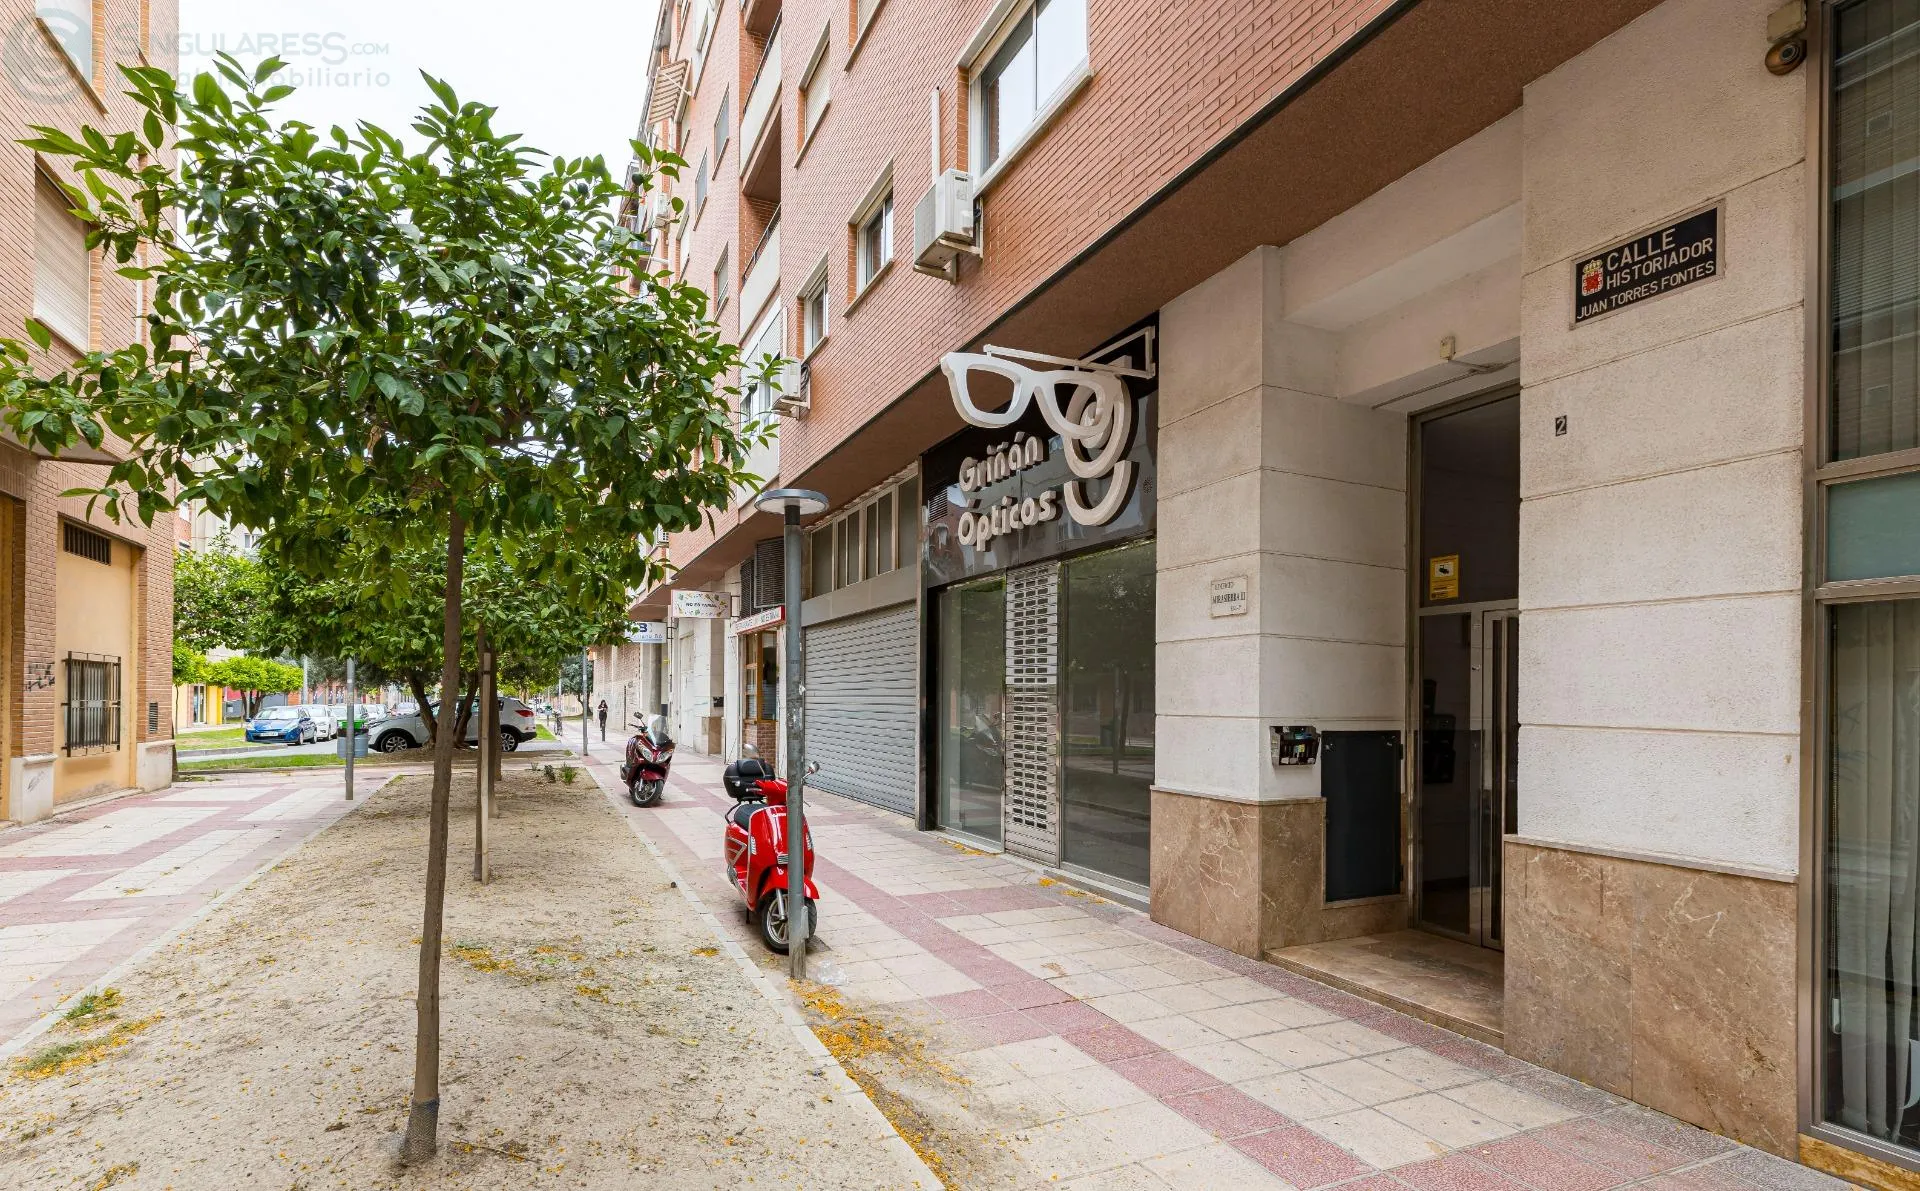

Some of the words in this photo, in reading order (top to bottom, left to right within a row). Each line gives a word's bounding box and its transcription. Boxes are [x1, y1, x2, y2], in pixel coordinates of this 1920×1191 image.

[1607, 228, 1676, 271] CALLE
[1607, 237, 1713, 290] HISTORIADOR
[1577, 298, 1608, 319] JUAN
[1609, 281, 1658, 308] TORRES
[1661, 260, 1714, 290] FONTES
[1556, 418, 1566, 434] 2
[959, 431, 1044, 492] Griñán
[958, 490, 1057, 551] Ópticos
